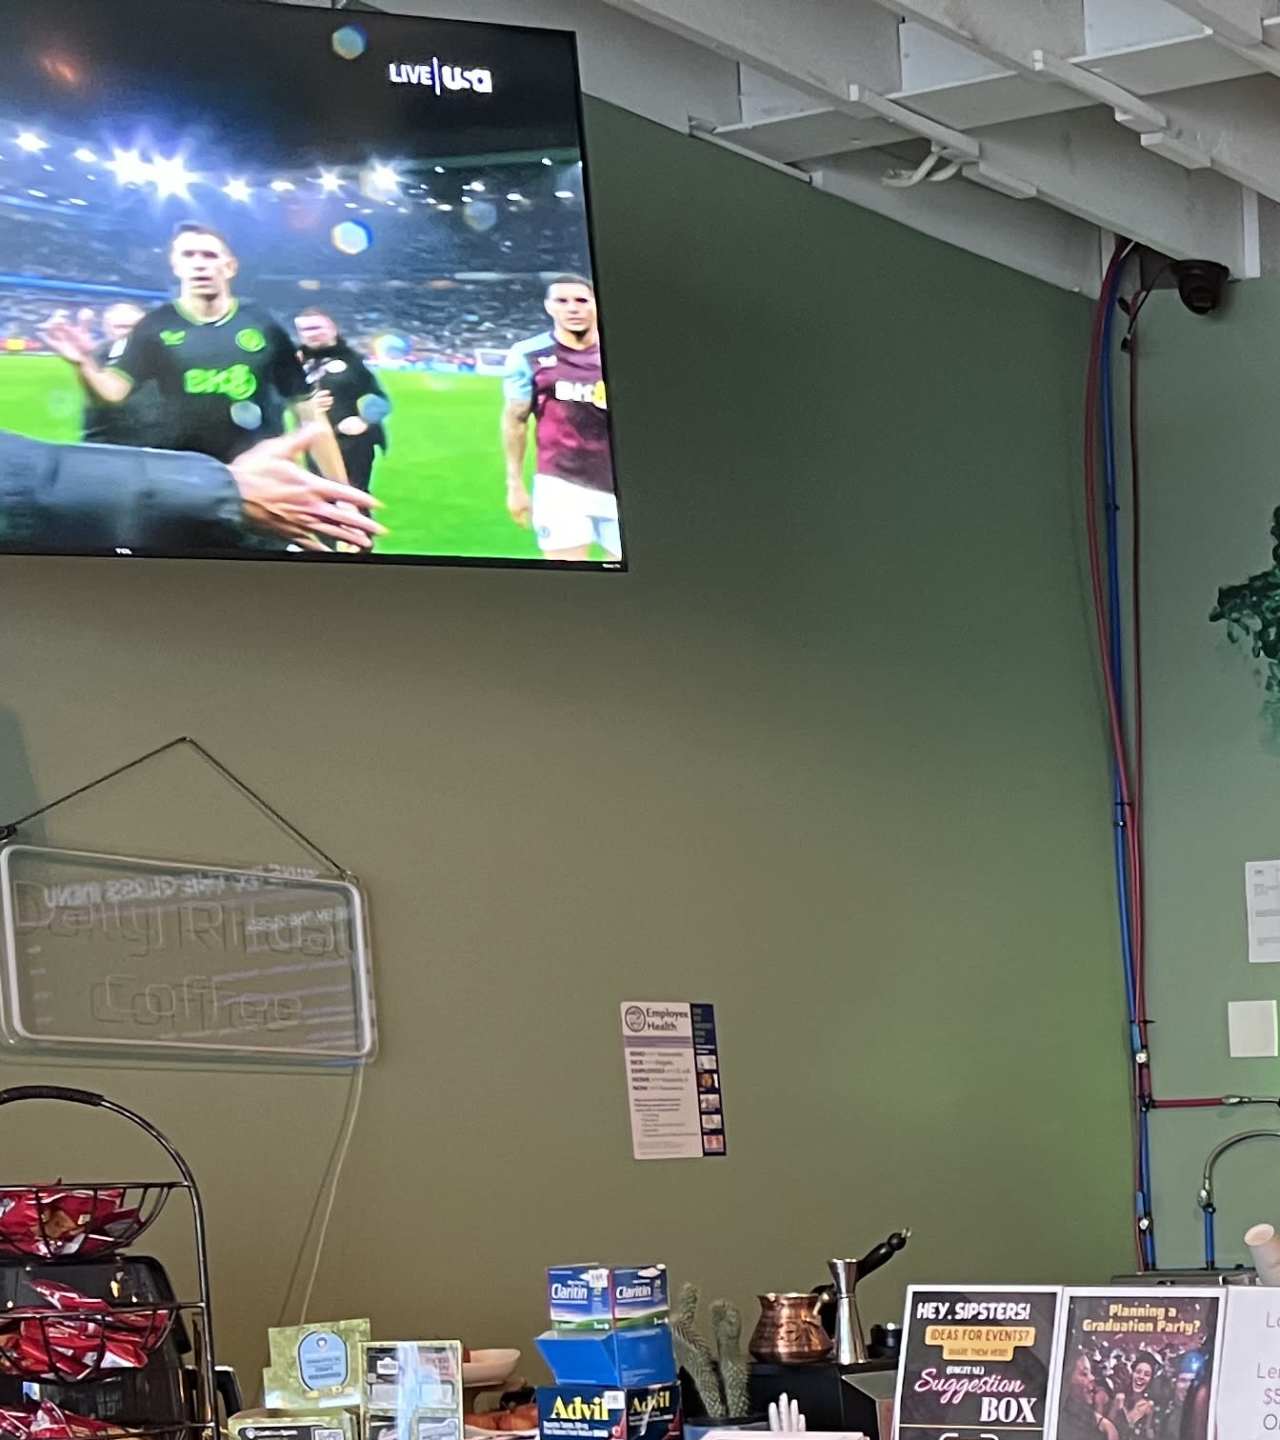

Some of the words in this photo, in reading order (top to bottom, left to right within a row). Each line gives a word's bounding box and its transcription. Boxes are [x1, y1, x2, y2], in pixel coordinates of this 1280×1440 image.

[389, 62, 432, 85] LIVE
[551, 1282, 589, 1301] Claritin
[615, 1284, 652, 1300] Claritin
[954, 1302, 1031, 1321] SIPSTERS!
[1108, 1304, 1166, 1319] Planning
[1168, 1307, 1177, 1318] a
[930, 1327, 959, 1341] IDEAS
[961, 1328, 983, 1341] FOR
[985, 1329, 1030, 1342] EVENTS?
[1082, 1318, 1154, 1333] Graduation
[1156, 1319, 1201, 1336] Party?
[914, 1367, 1025, 1405] Suggestion
[552, 1396, 610, 1422] Advil
[630, 1395, 670, 1415] Advil
[979, 1397, 1037, 1424] BOX
